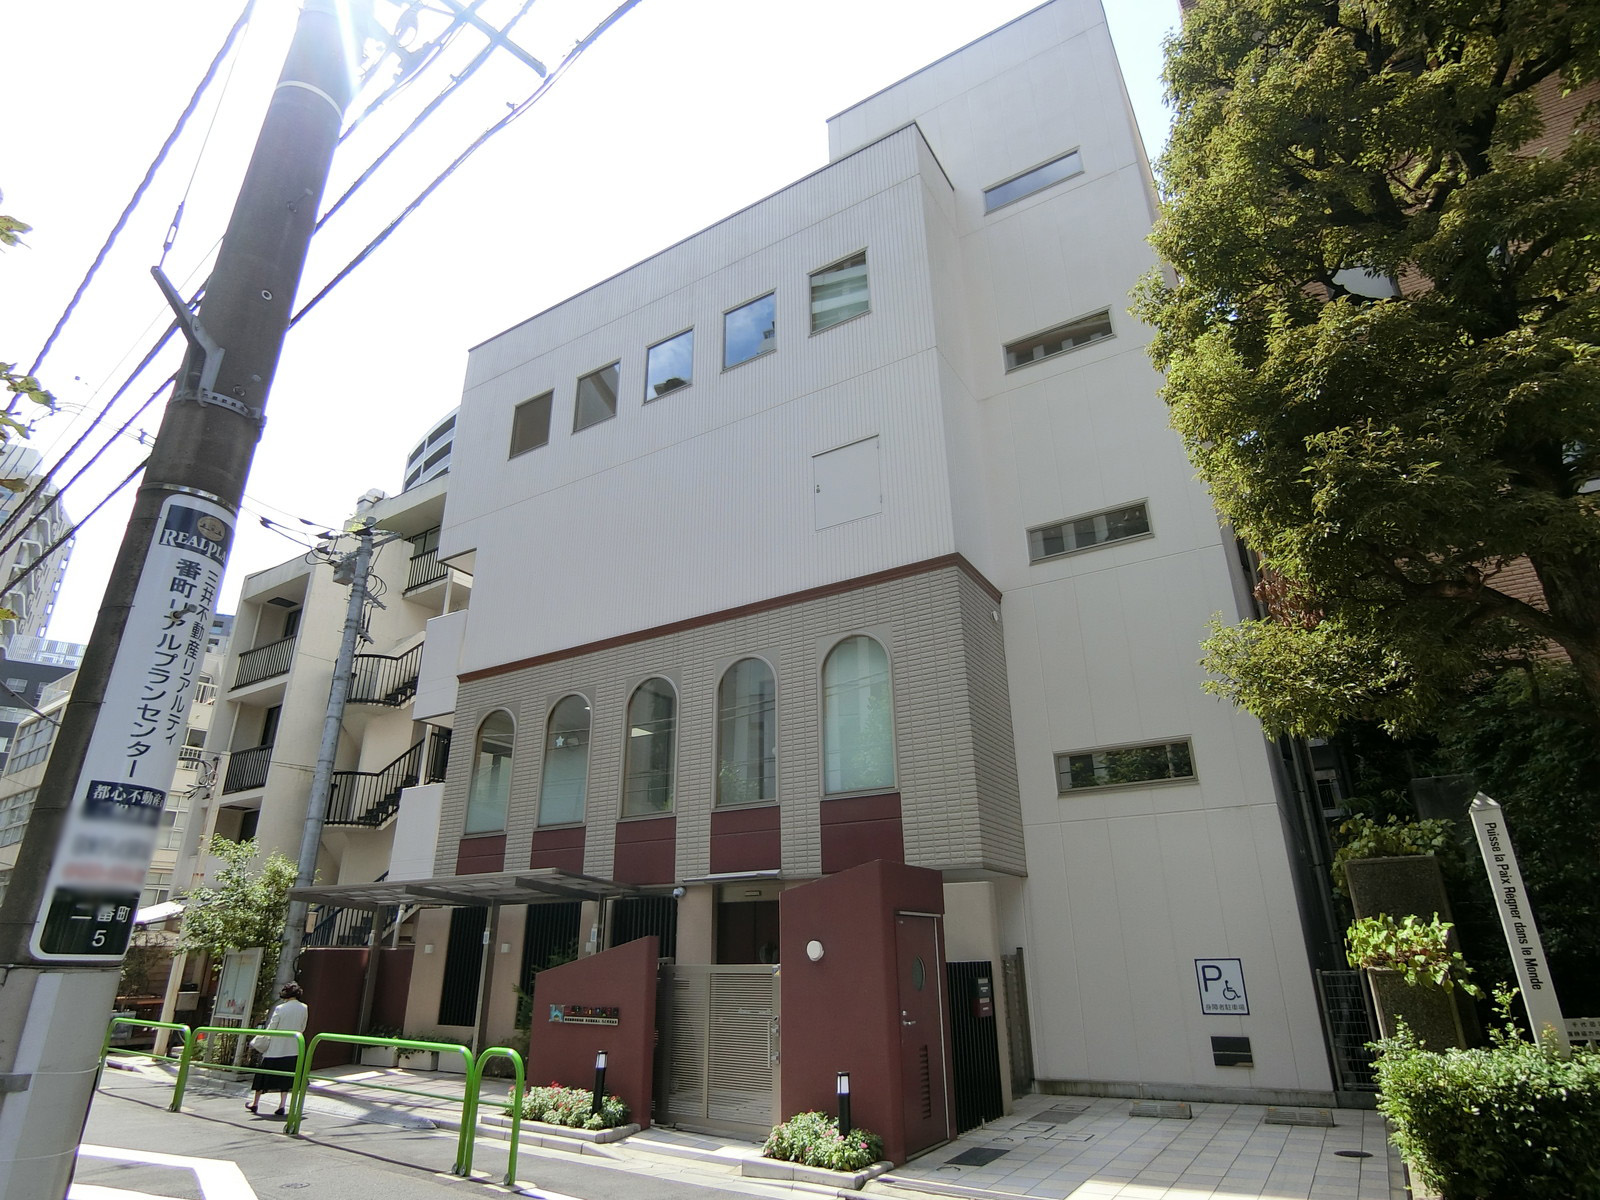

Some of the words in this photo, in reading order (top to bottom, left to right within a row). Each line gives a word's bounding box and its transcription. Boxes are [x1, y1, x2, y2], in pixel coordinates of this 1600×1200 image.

[93, 784, 163, 807] 都心不動産
[1485, 822, 1501, 852] Puisse
[1494, 854, 1505, 863] la
[1497, 864, 1512, 885] Paix
[92, 929, 107, 948] 5
[1514, 922, 1528, 945] dans
[1521, 947, 1533, 956] le
[1202, 965, 1222, 992] P
[1524, 958, 1543, 991] Monde
